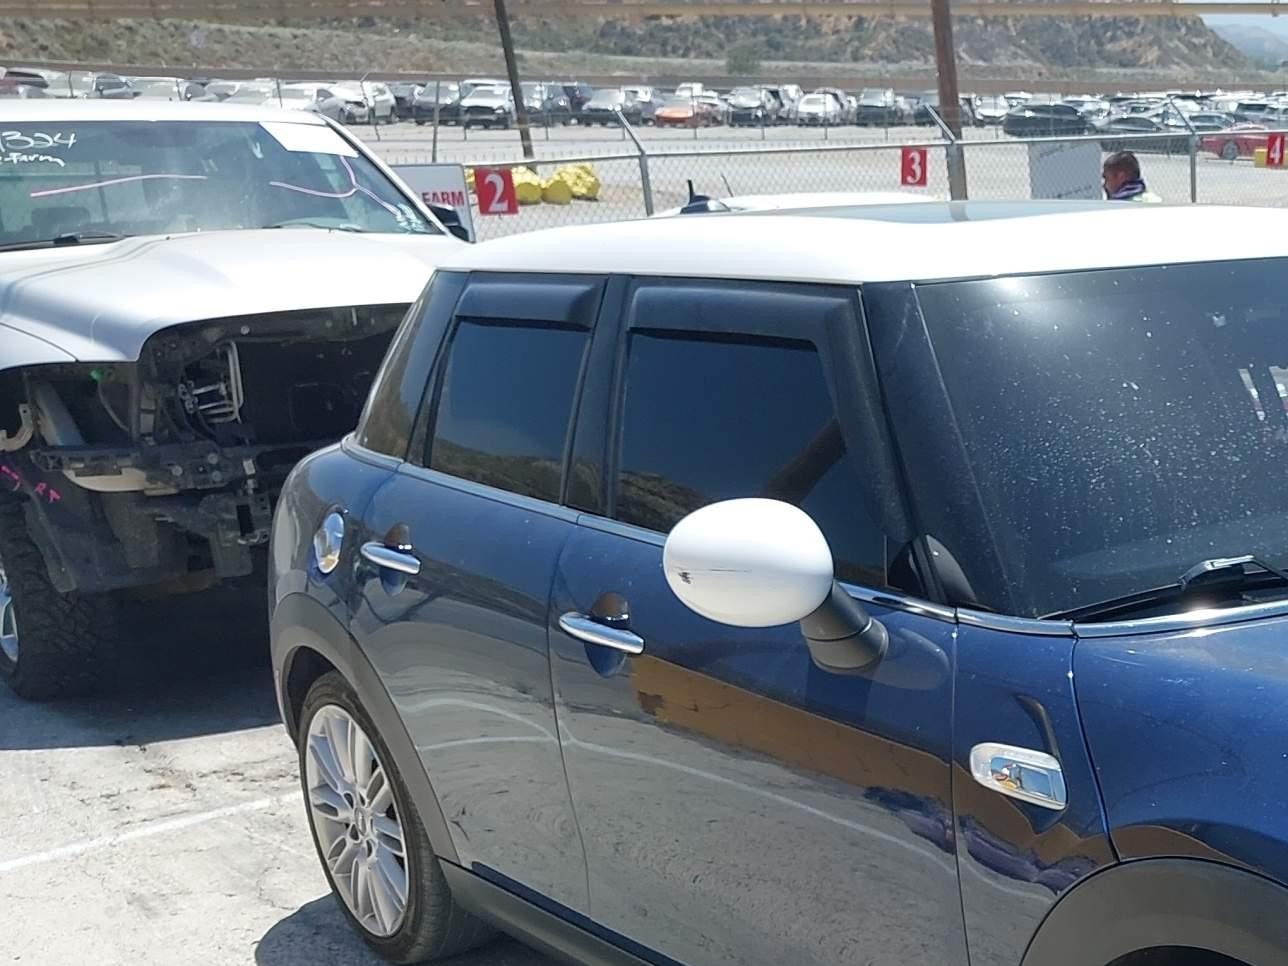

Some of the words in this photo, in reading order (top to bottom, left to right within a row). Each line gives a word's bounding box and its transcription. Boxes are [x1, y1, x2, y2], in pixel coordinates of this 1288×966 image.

[1269, 132, 1282, 164] 4
[906, 149, 922, 184] 3
[484, 173, 509, 212] 2
